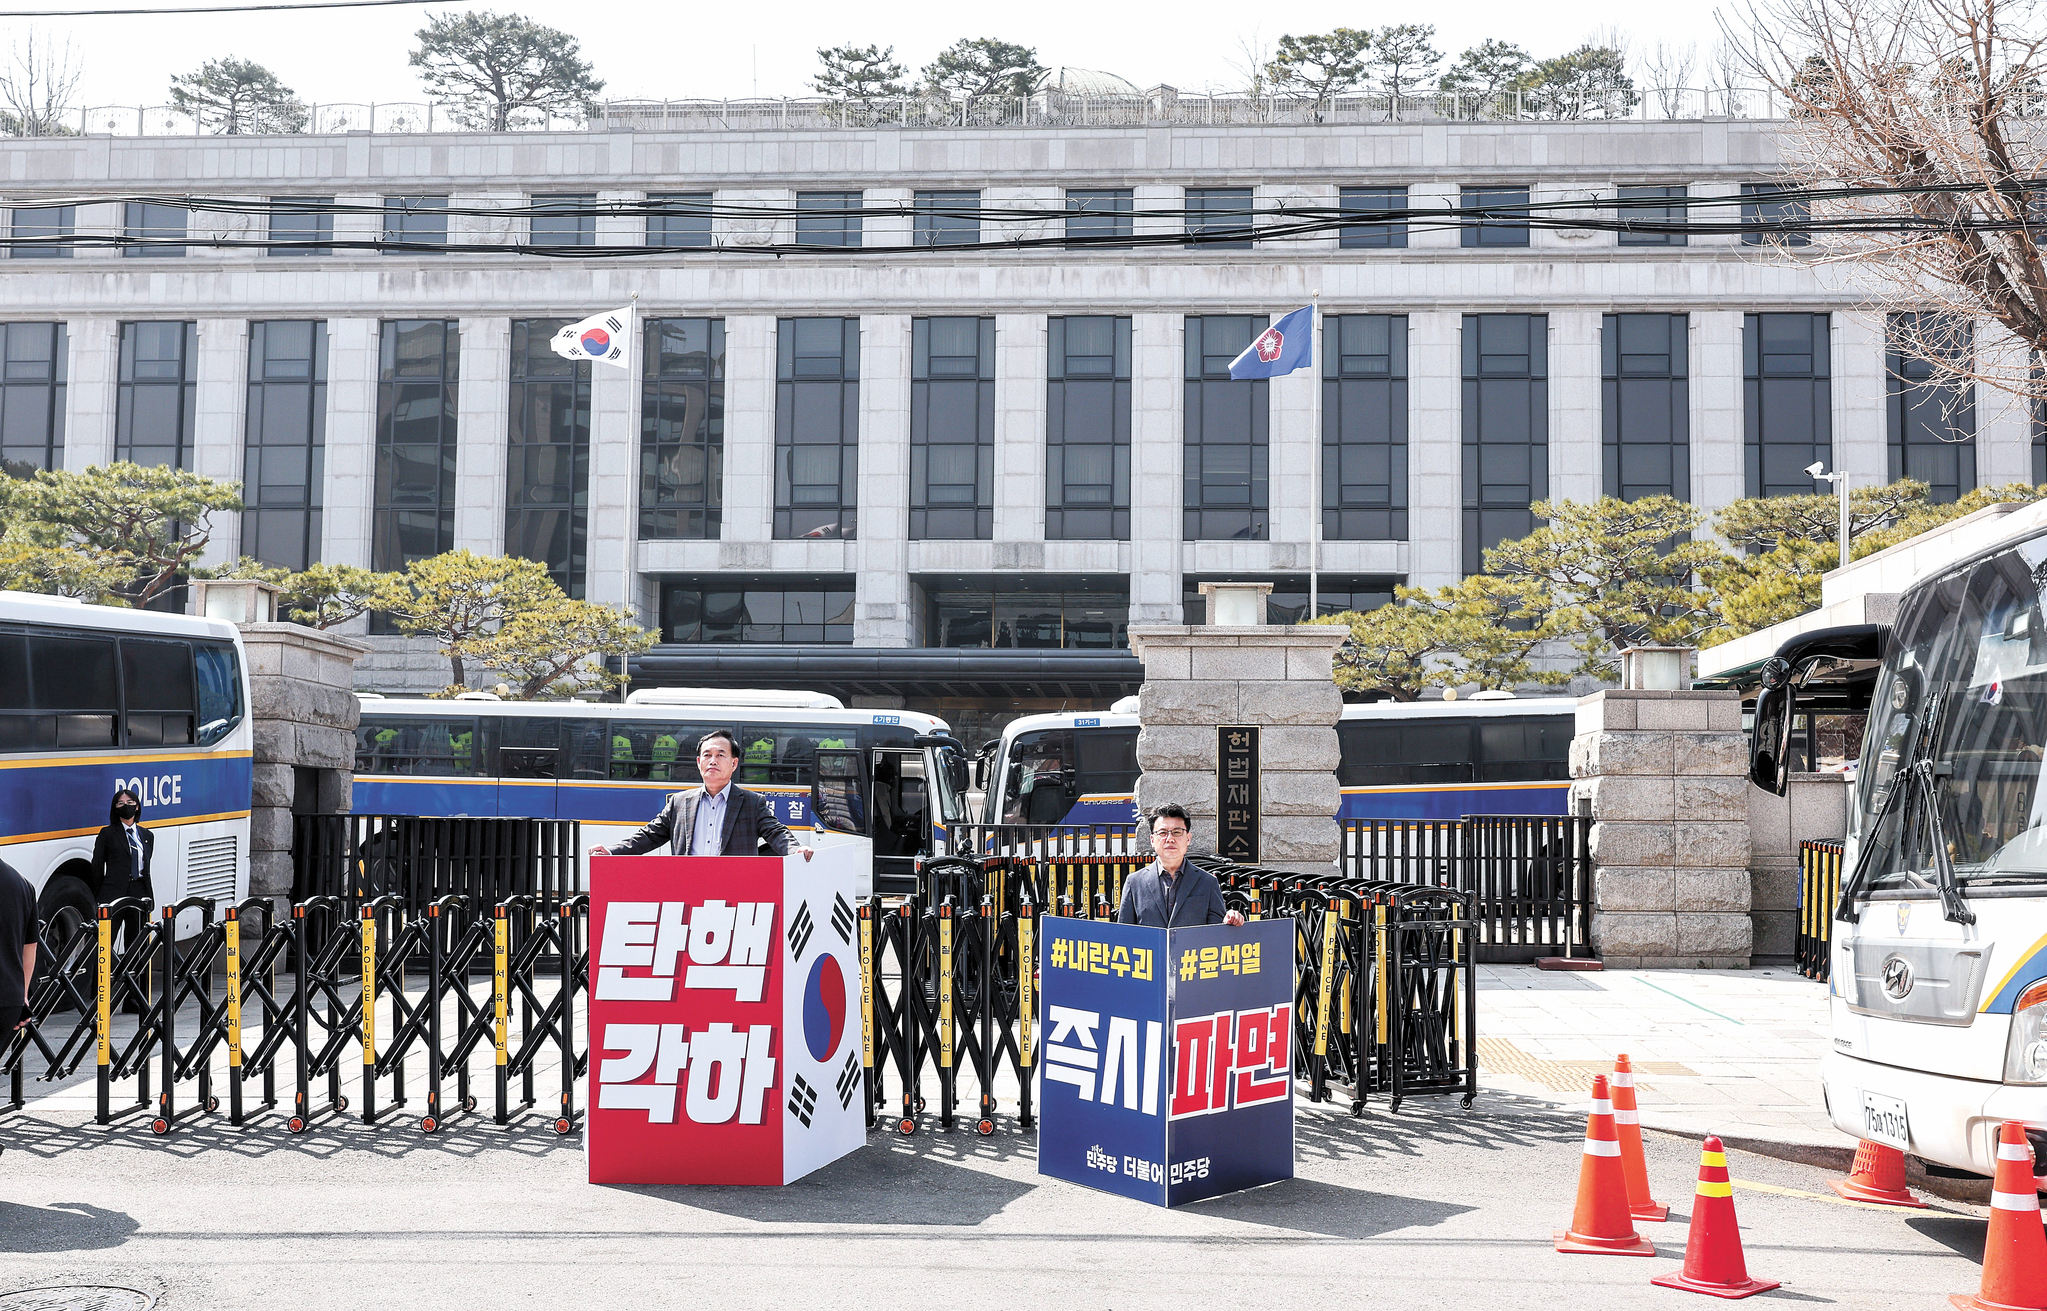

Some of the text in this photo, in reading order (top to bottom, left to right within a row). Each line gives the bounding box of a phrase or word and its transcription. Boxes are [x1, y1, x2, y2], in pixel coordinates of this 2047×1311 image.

[1227, 731, 1251, 857] 헌법재판소
[97, 946, 107, 1051] POLICE LINE
[227, 946, 238, 1052] 질서유지선
[363, 945, 371, 1050] POLICE LINE
[495, 945, 504, 1051] 질서유지선
[595, 900, 777, 1002] 탄핵
[862, 946, 870, 1004] POLICE
[941, 945, 950, 1053] 질서유지선
[1022, 945, 1030, 1003] POLICE
[1051, 937, 1153, 981] #내란수괴
[1180, 941, 1261, 982] #윤석열
[1325, 937, 1335, 993] POLICE
[598, 1022, 777, 1125] 각하
[1046, 1004, 1162, 1116] 즉시
[1169, 1002, 1292, 1121] 파면
[1086, 1150, 1118, 1174] 민주당
[1123, 1155, 1211, 1185] 더불어 민주당
